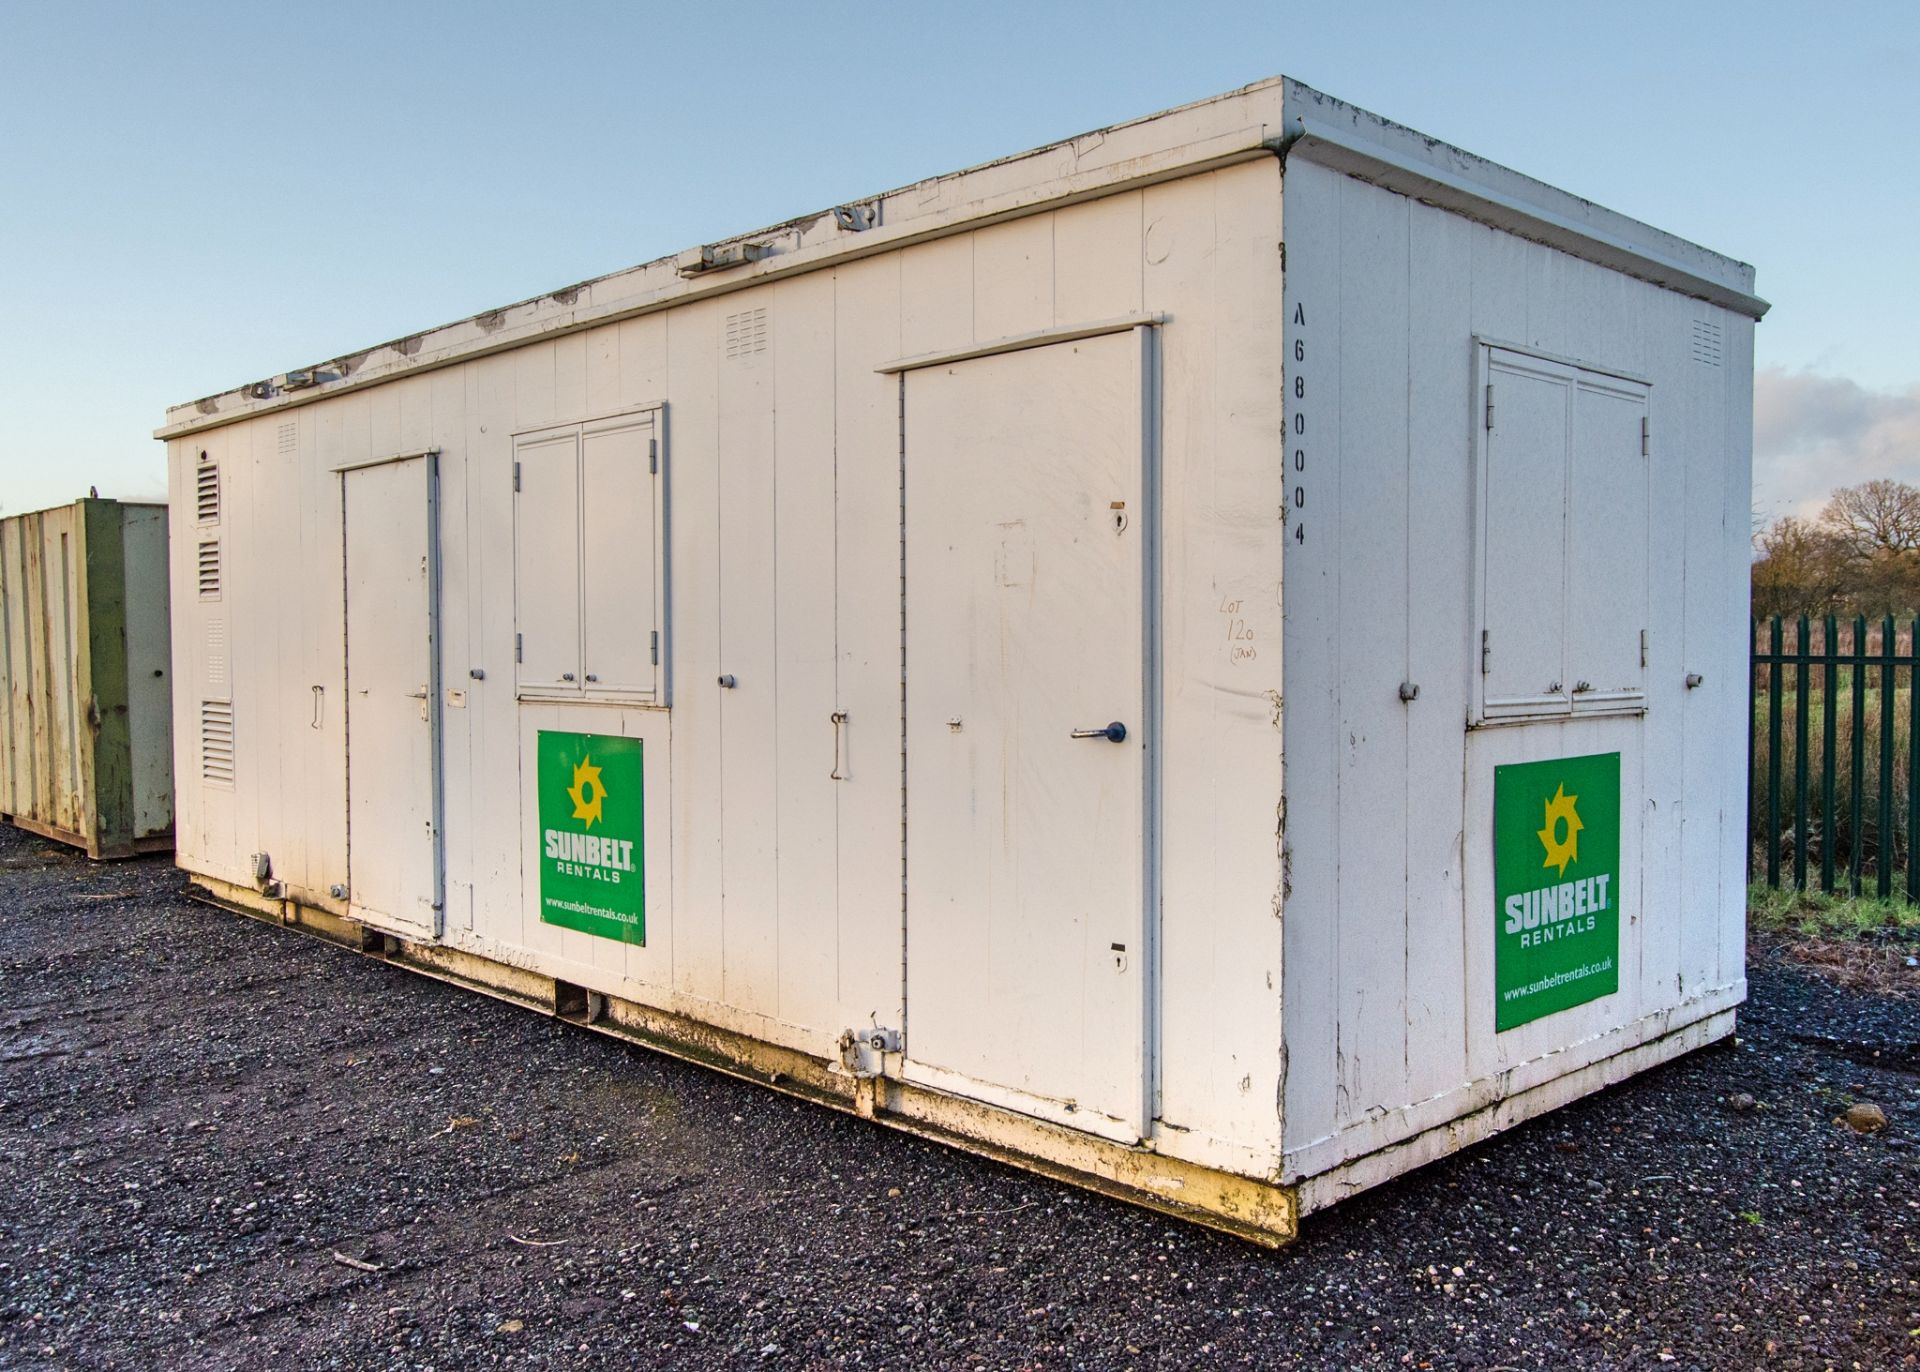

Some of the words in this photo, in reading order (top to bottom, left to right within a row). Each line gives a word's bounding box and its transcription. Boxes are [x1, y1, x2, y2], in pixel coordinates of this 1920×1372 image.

[1220, 595, 1244, 613] LOT
[1228, 619, 1253, 640] 120
[545, 829, 633, 871] SUNBELT
[557, 861, 620, 884] RENTALS
[545, 897, 638, 925] www.sunbeltrentals.co.uk
[1505, 874, 1609, 934] SUNBELT
[1520, 916, 1596, 949] RENTALS
[1504, 956, 1612, 1001] www.sunbeltrentals.co.uk
